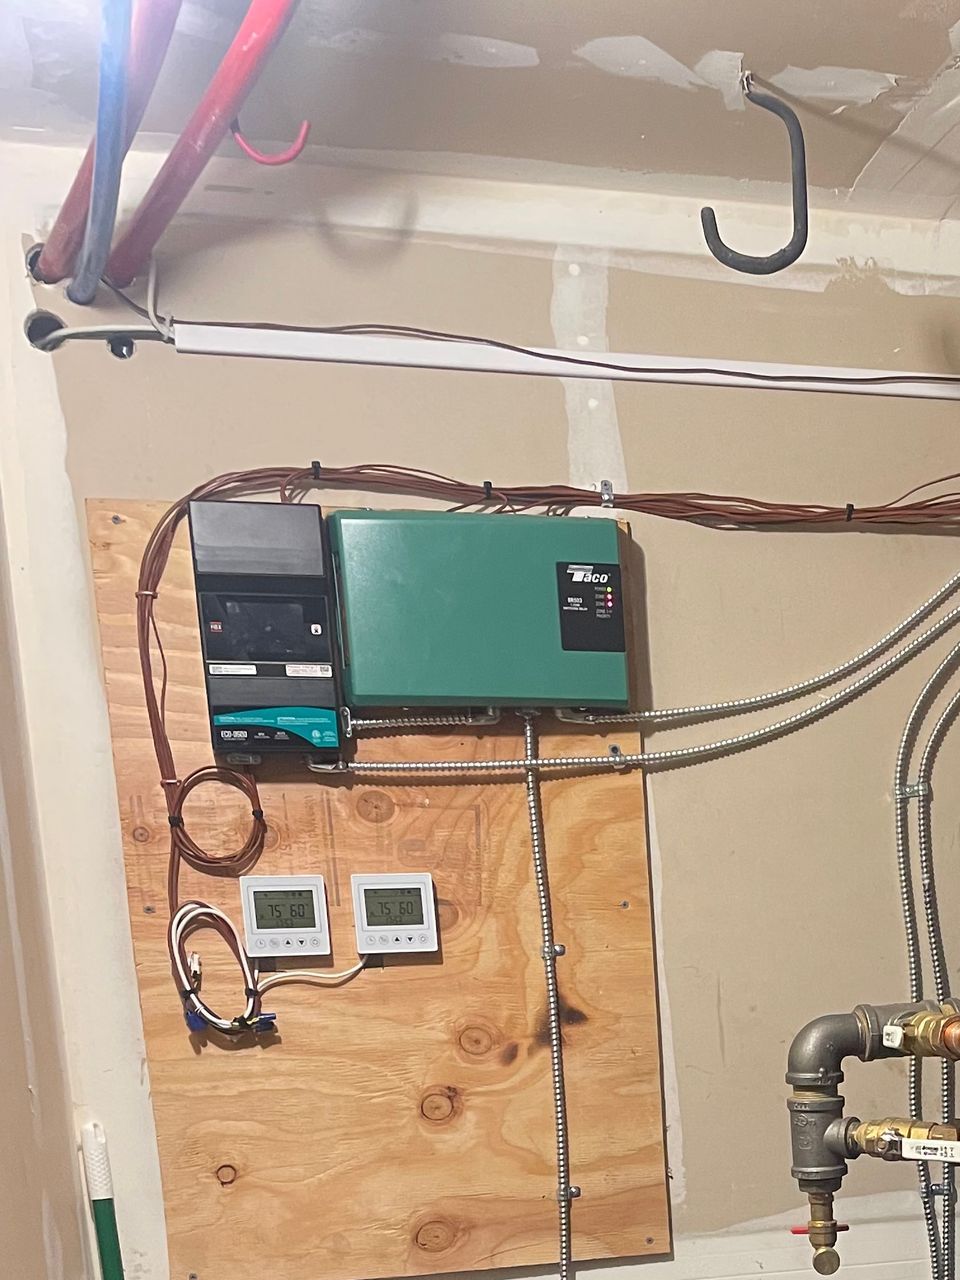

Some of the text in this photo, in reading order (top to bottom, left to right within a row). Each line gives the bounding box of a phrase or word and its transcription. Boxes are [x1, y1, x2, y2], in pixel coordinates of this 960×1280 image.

[567, 565, 608, 582] Taco
[267, 903, 304, 918] 75 60
[377, 901, 413, 915] 75 60
